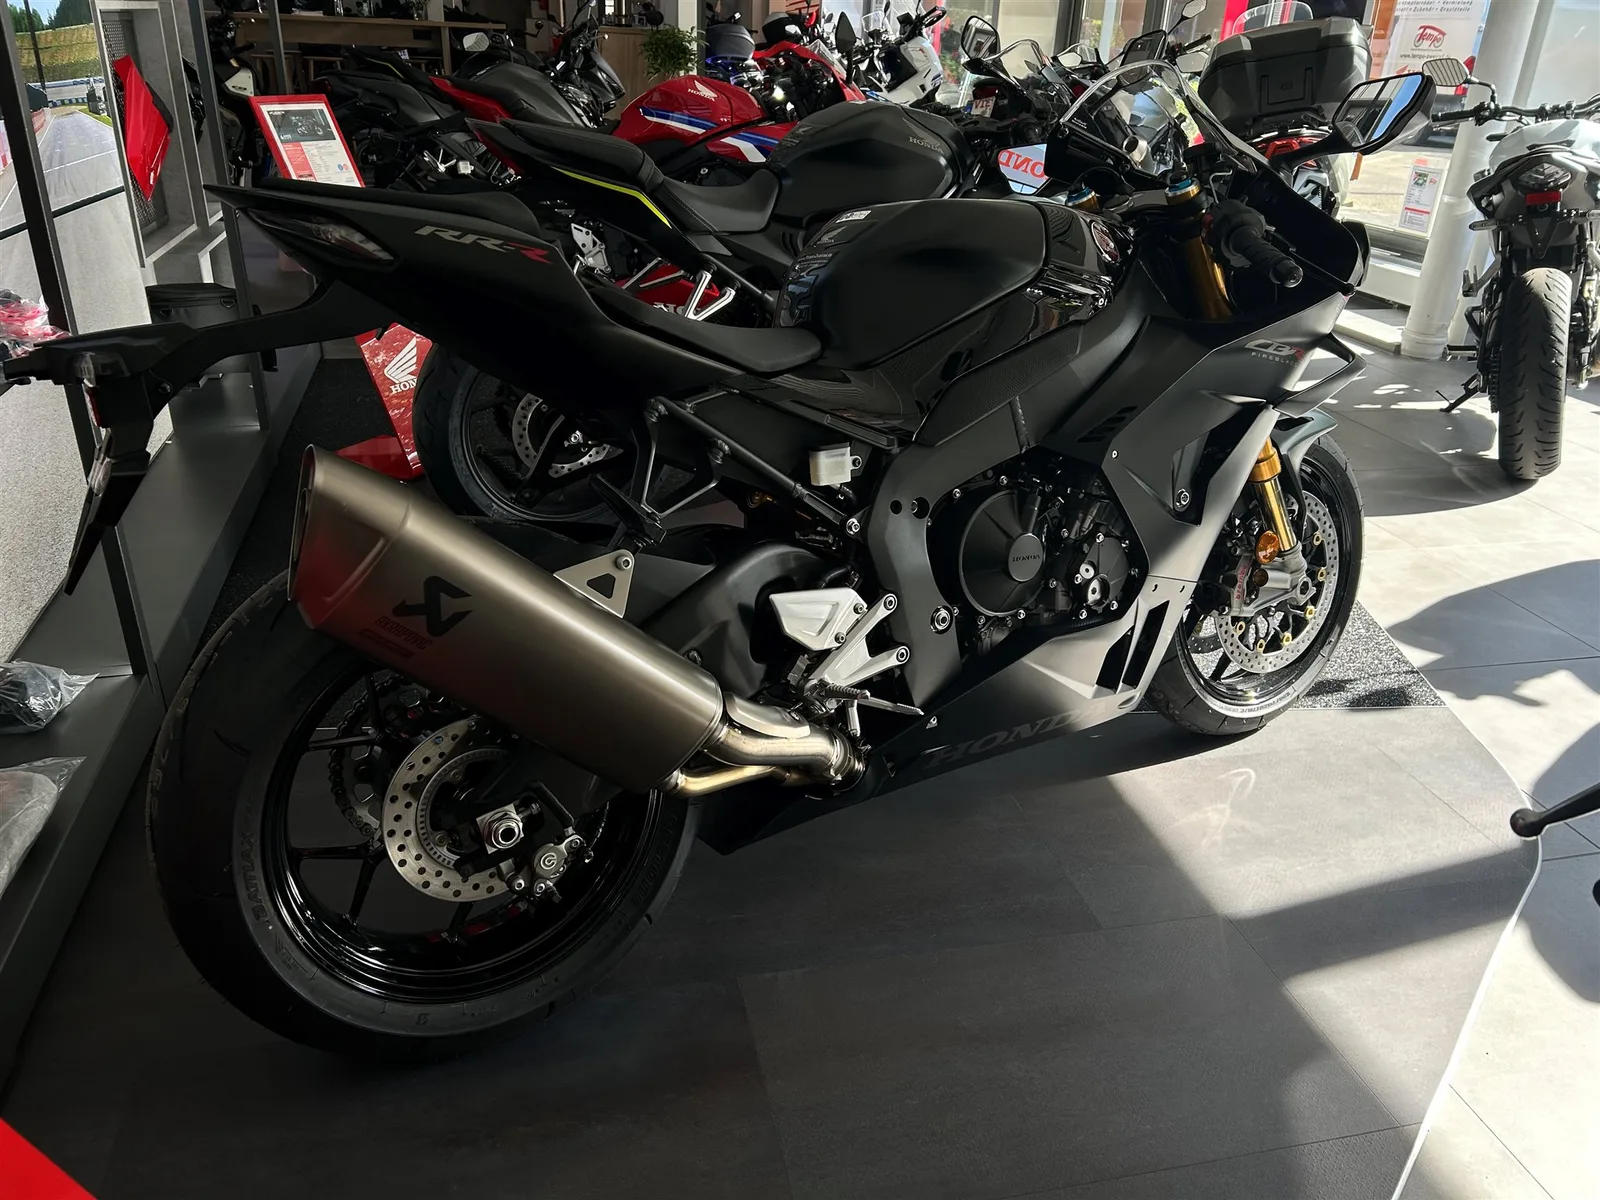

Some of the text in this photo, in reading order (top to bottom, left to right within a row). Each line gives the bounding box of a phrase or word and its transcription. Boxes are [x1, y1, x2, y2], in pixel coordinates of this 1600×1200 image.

[1415, 25, 1447, 47] Tempo
[688, 88, 716, 102] HONDA
[908, 136, 945, 155] HONDA
[390, 378, 417, 395] HON
[923, 703, 1105, 771] HONDA
